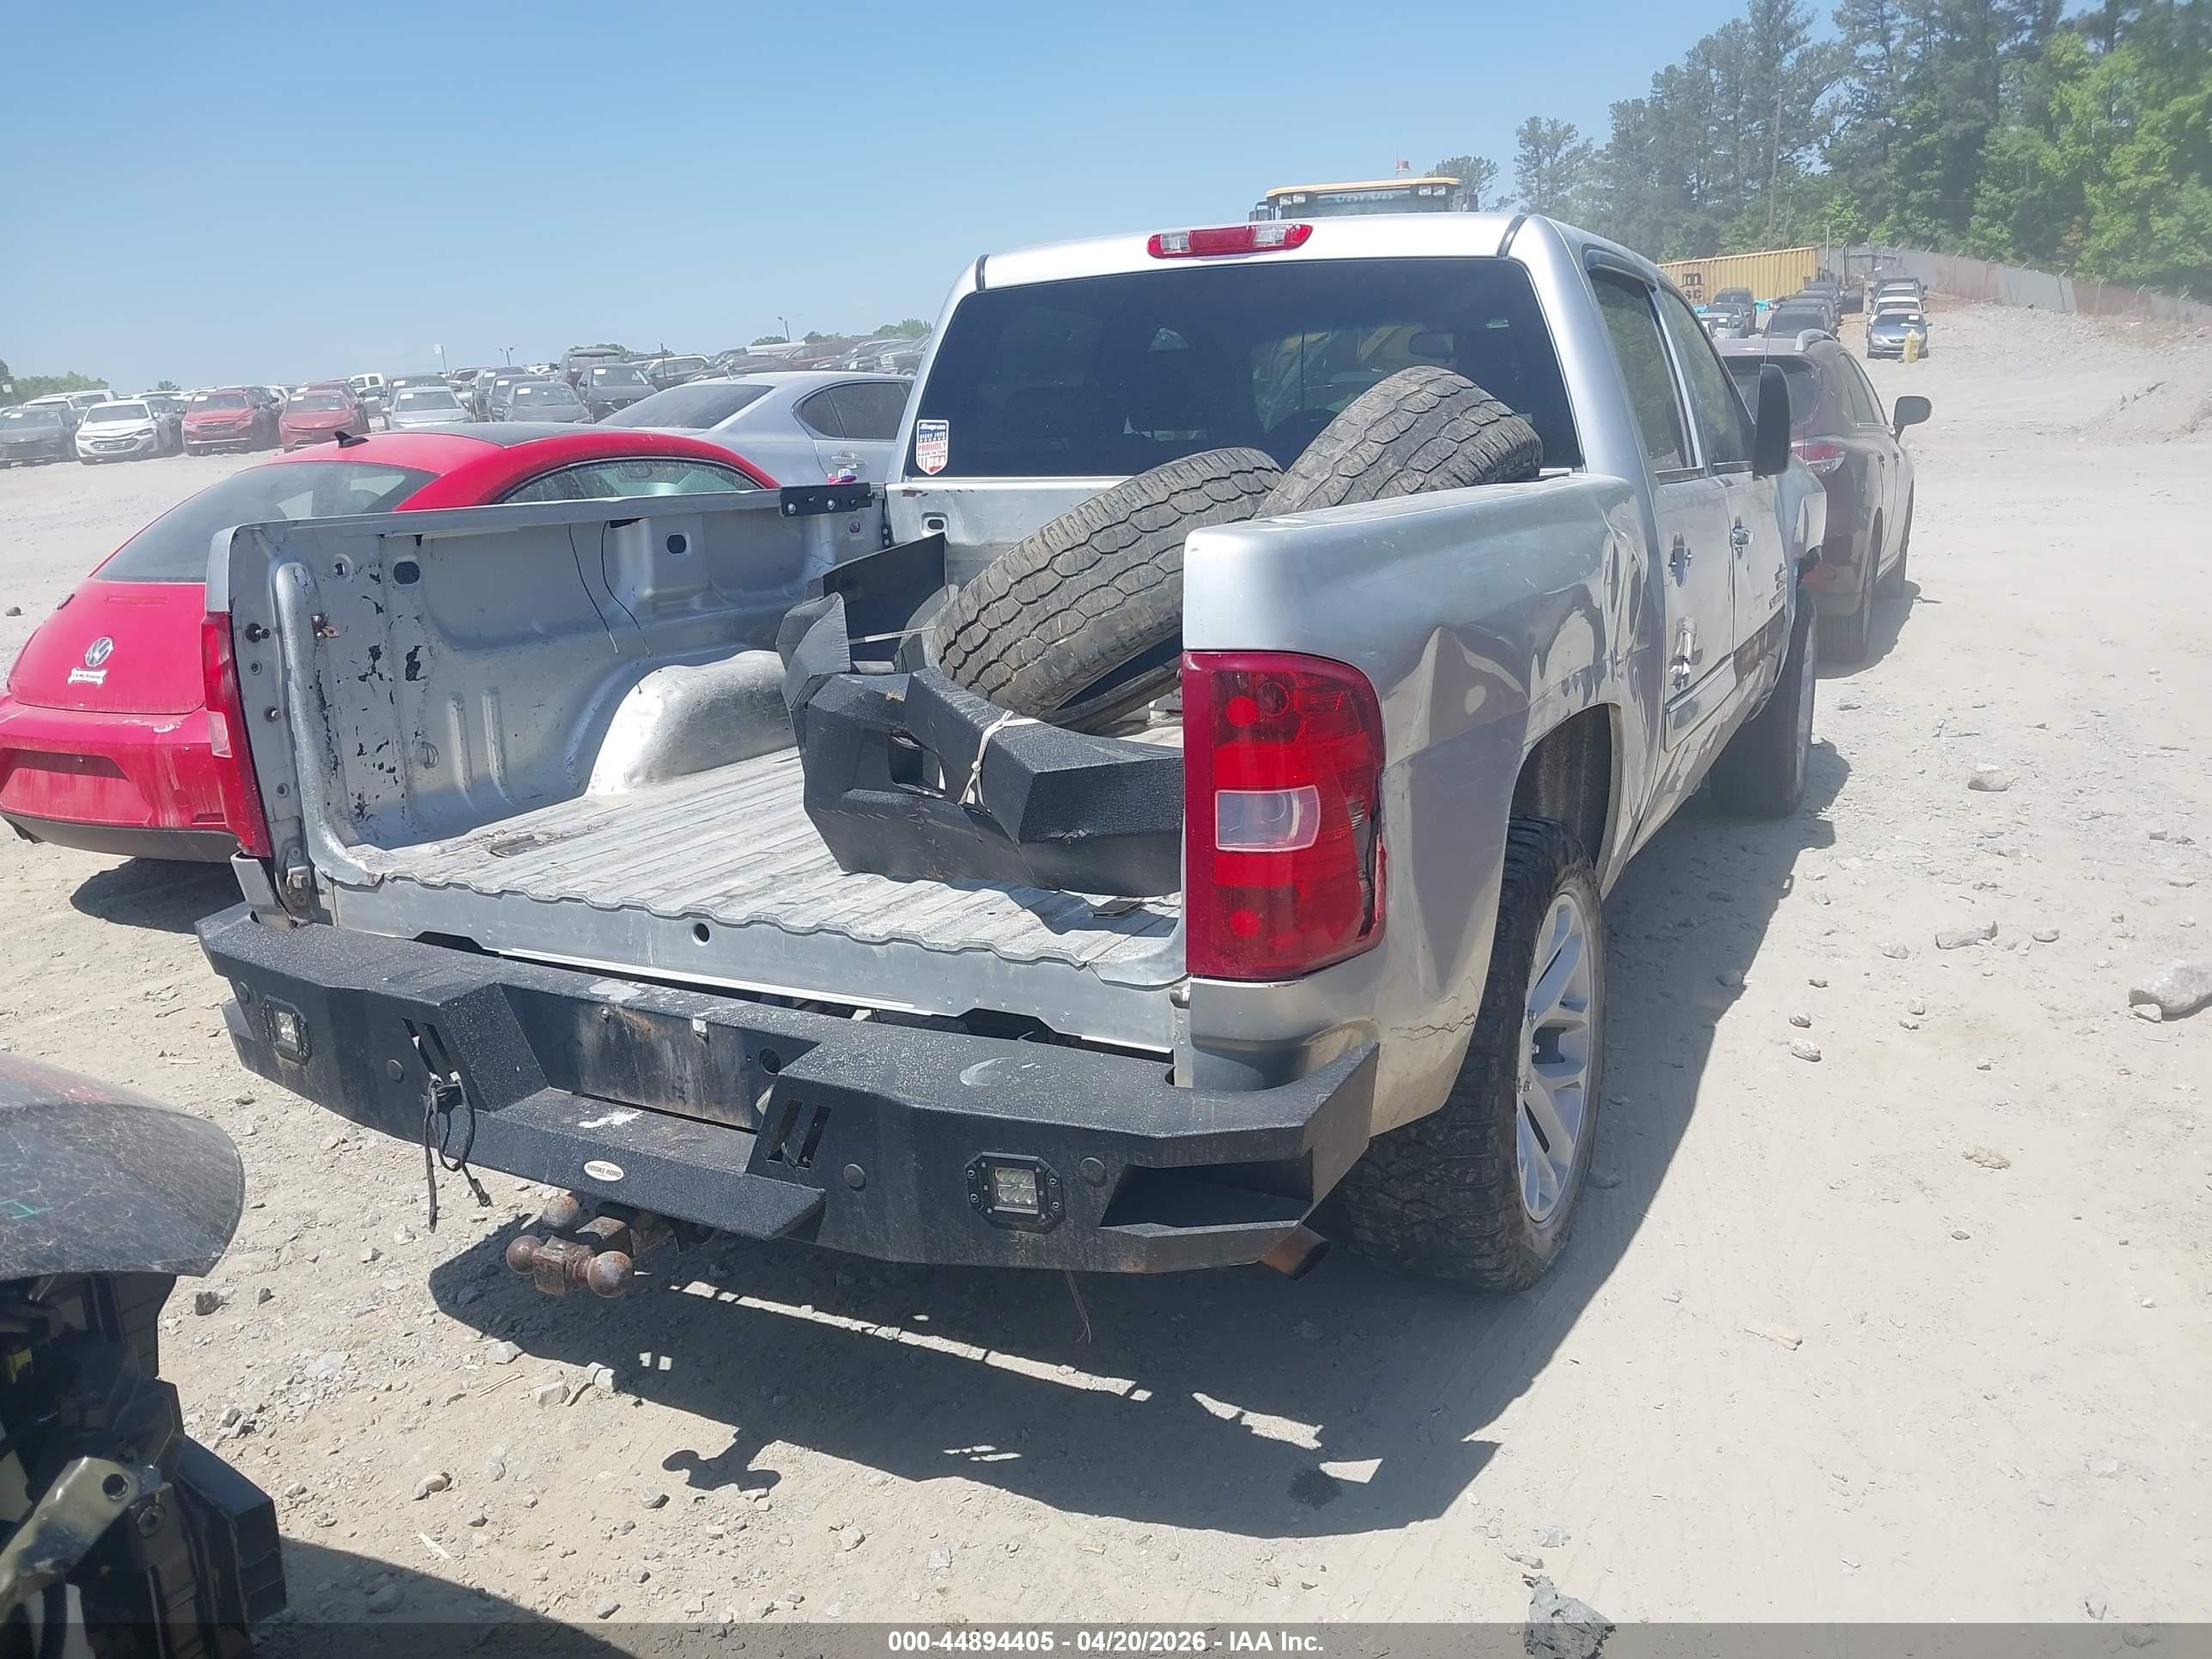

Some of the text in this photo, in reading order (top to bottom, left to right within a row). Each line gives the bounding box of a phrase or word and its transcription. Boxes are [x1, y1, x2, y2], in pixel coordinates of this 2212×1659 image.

[1334, 192, 1394, 204] VOLVO
[918, 442, 947, 452] PROUDLY
[929, 457, 945, 467] USA
